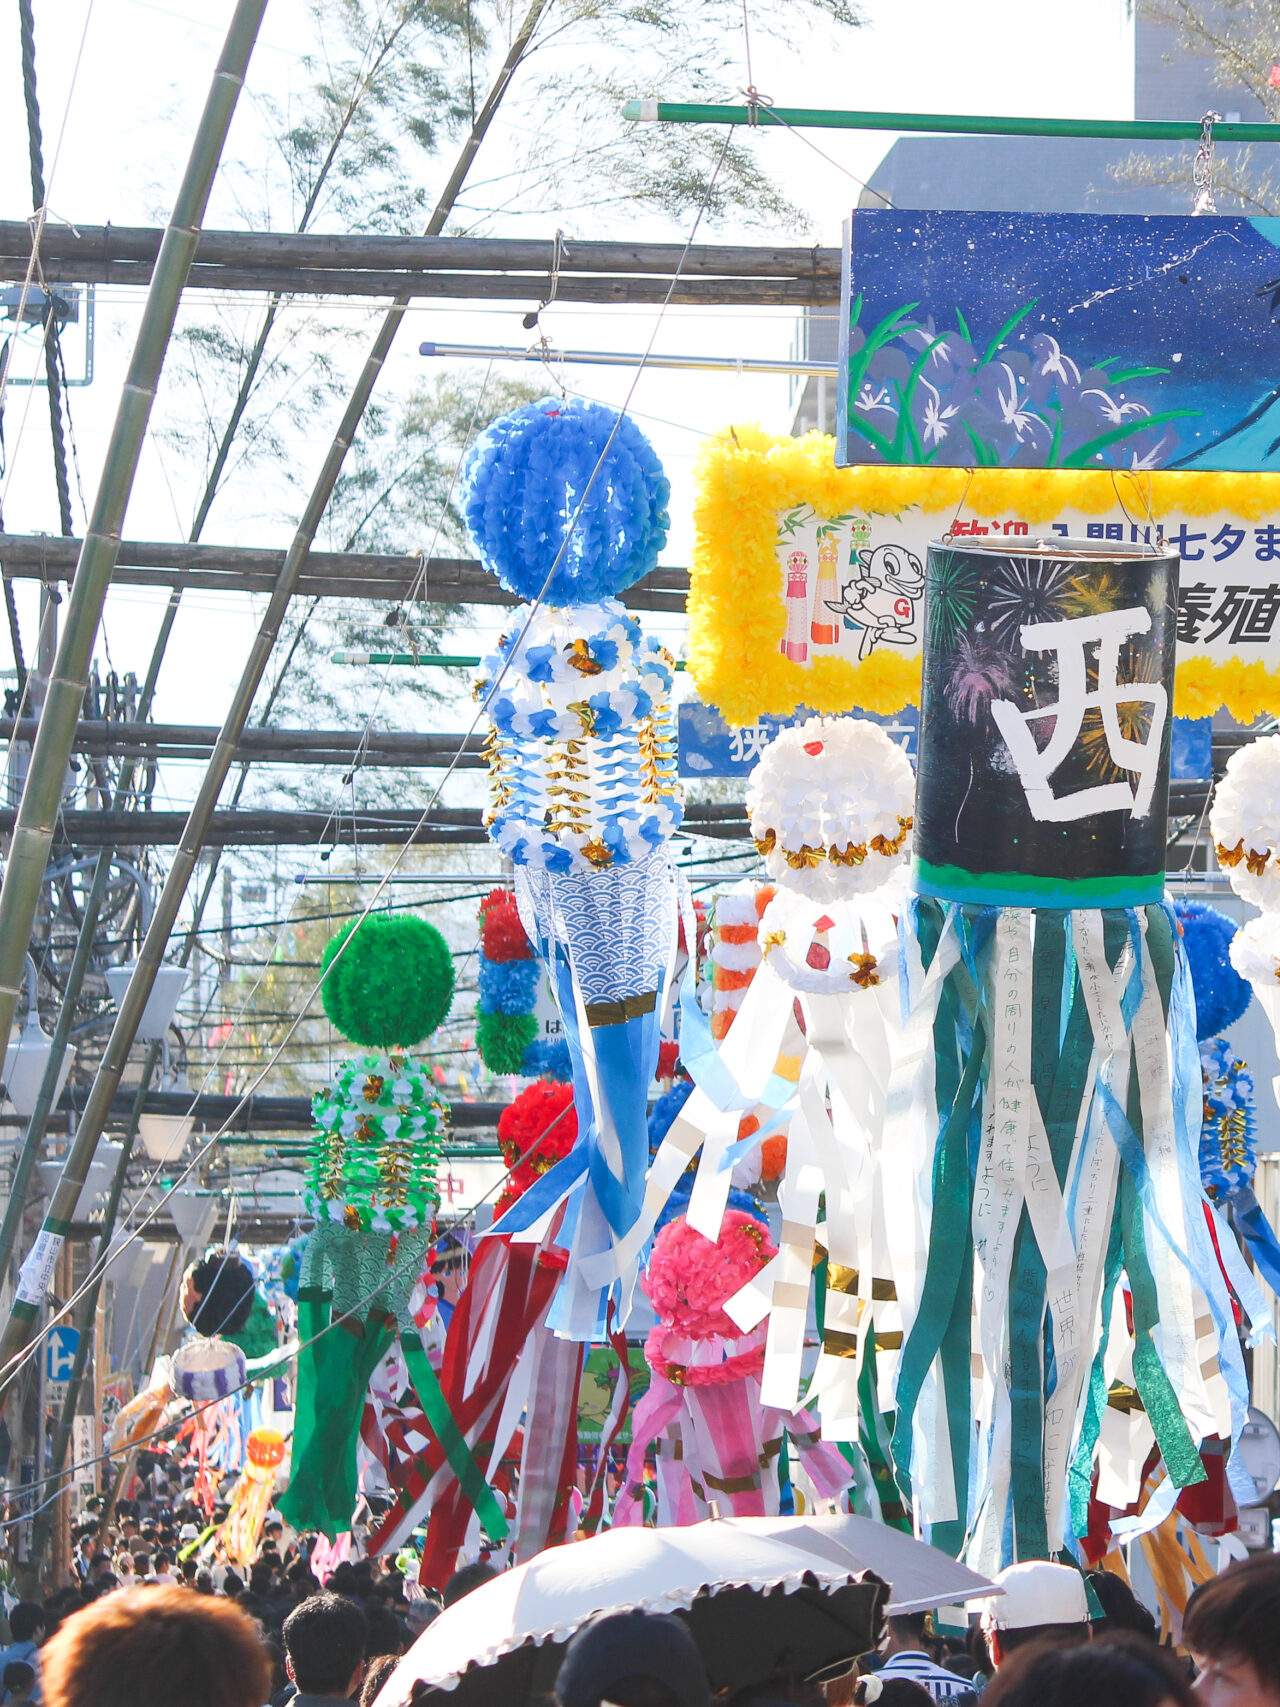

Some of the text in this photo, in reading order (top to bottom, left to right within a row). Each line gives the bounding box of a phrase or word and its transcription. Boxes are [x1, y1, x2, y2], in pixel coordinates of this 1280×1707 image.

[894, 598, 911, 618] G
[992, 607, 1168, 821] 西
[728, 719, 918, 763] 狭立
